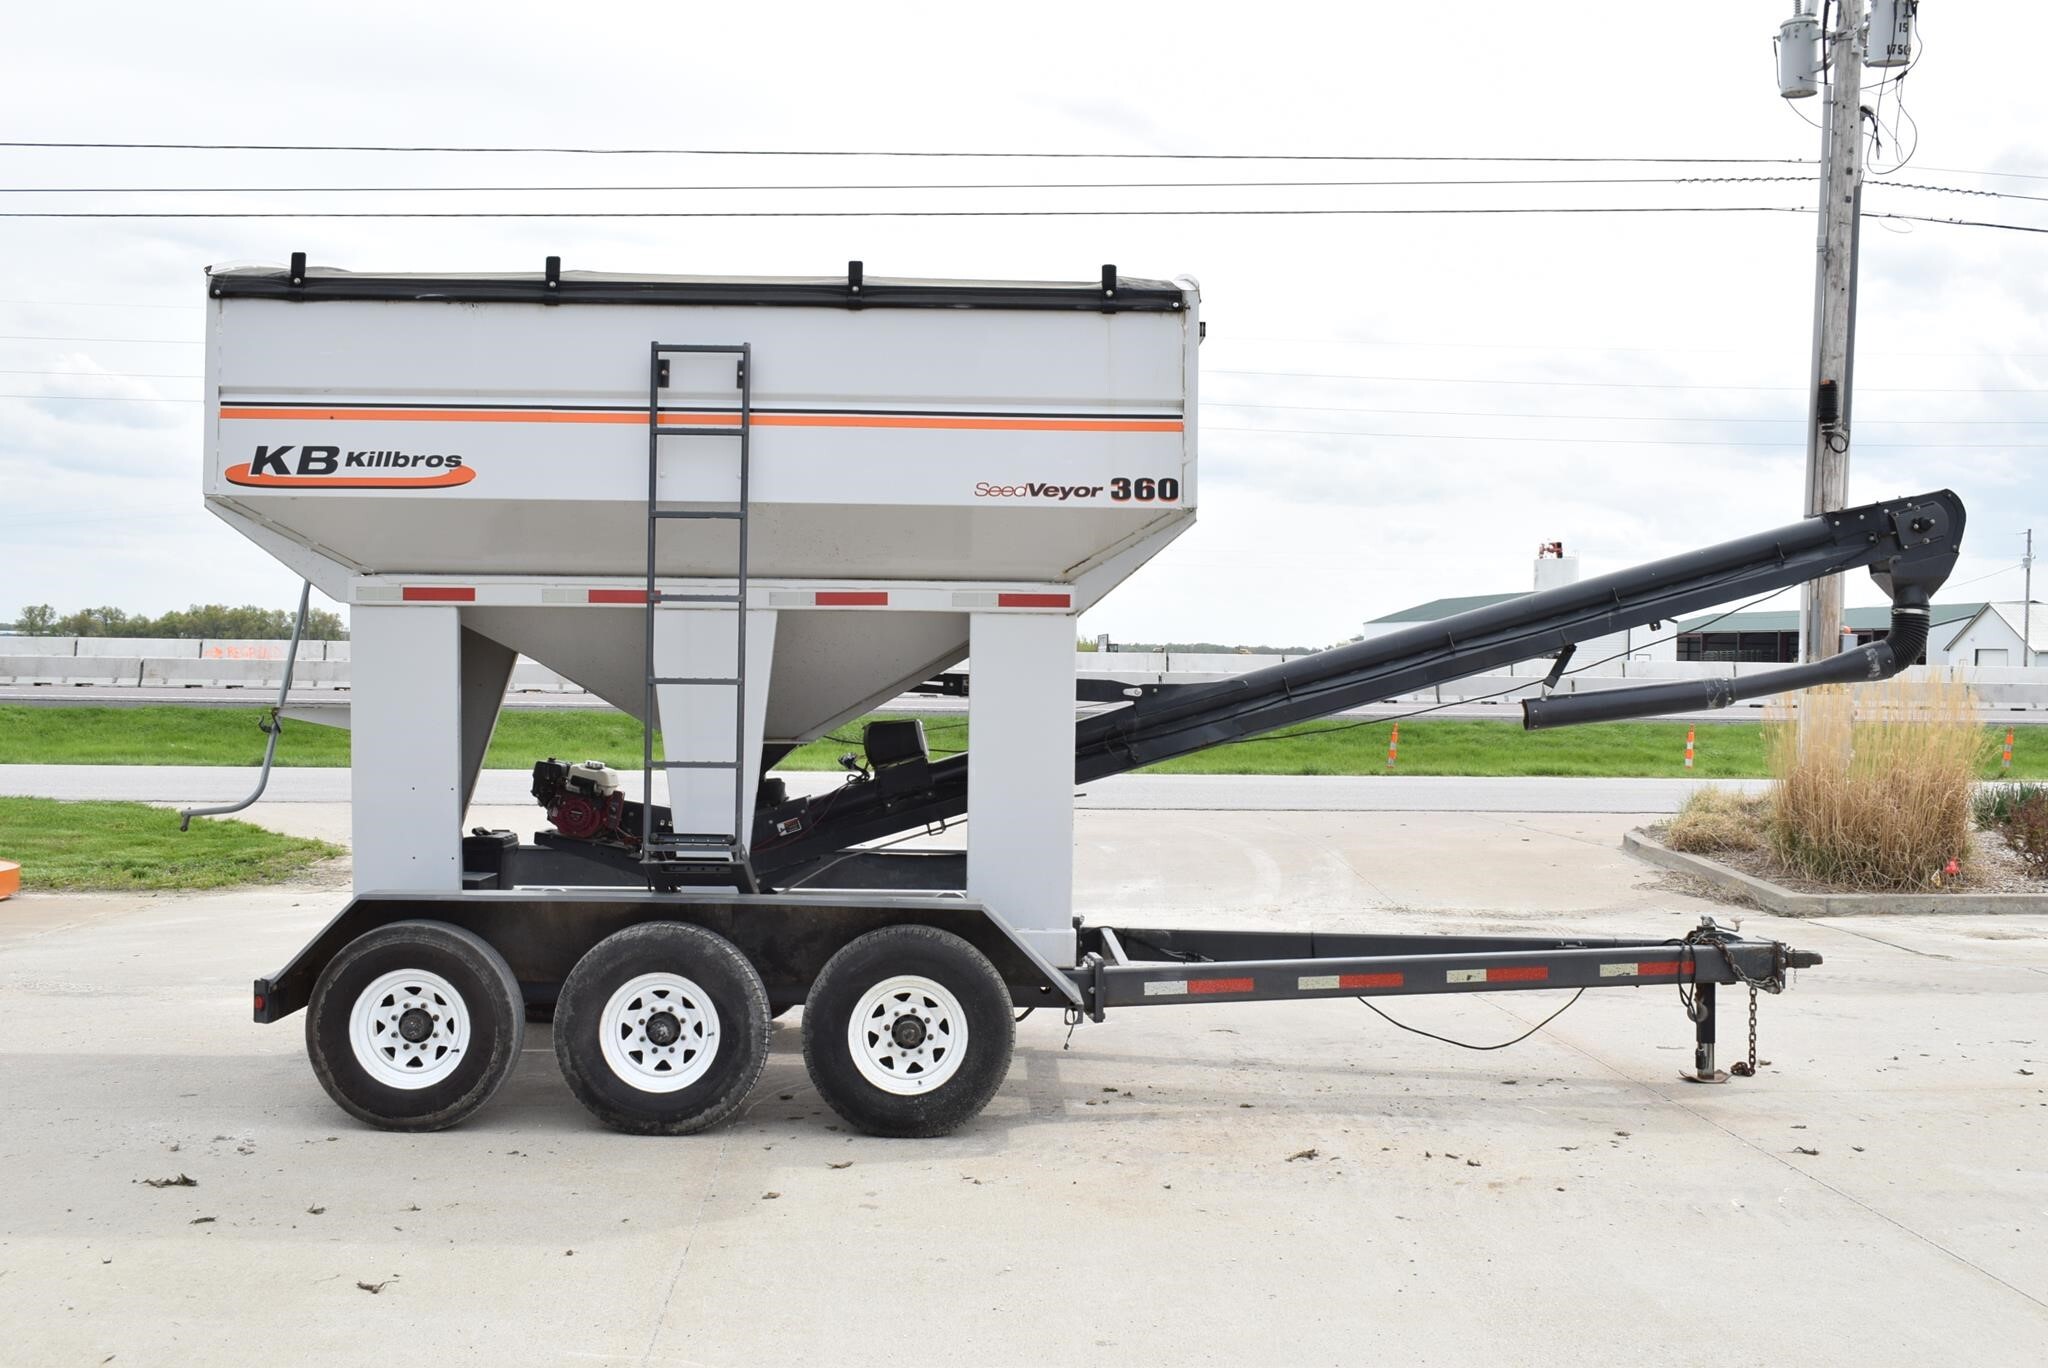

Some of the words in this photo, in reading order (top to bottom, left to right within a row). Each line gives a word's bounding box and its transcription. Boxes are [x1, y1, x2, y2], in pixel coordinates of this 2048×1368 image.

[250, 445, 340, 475] KB
[345, 451, 462, 468] Killbros
[974, 482, 1103, 500] SeedVeyor
[1110, 477, 1179, 502] 360
